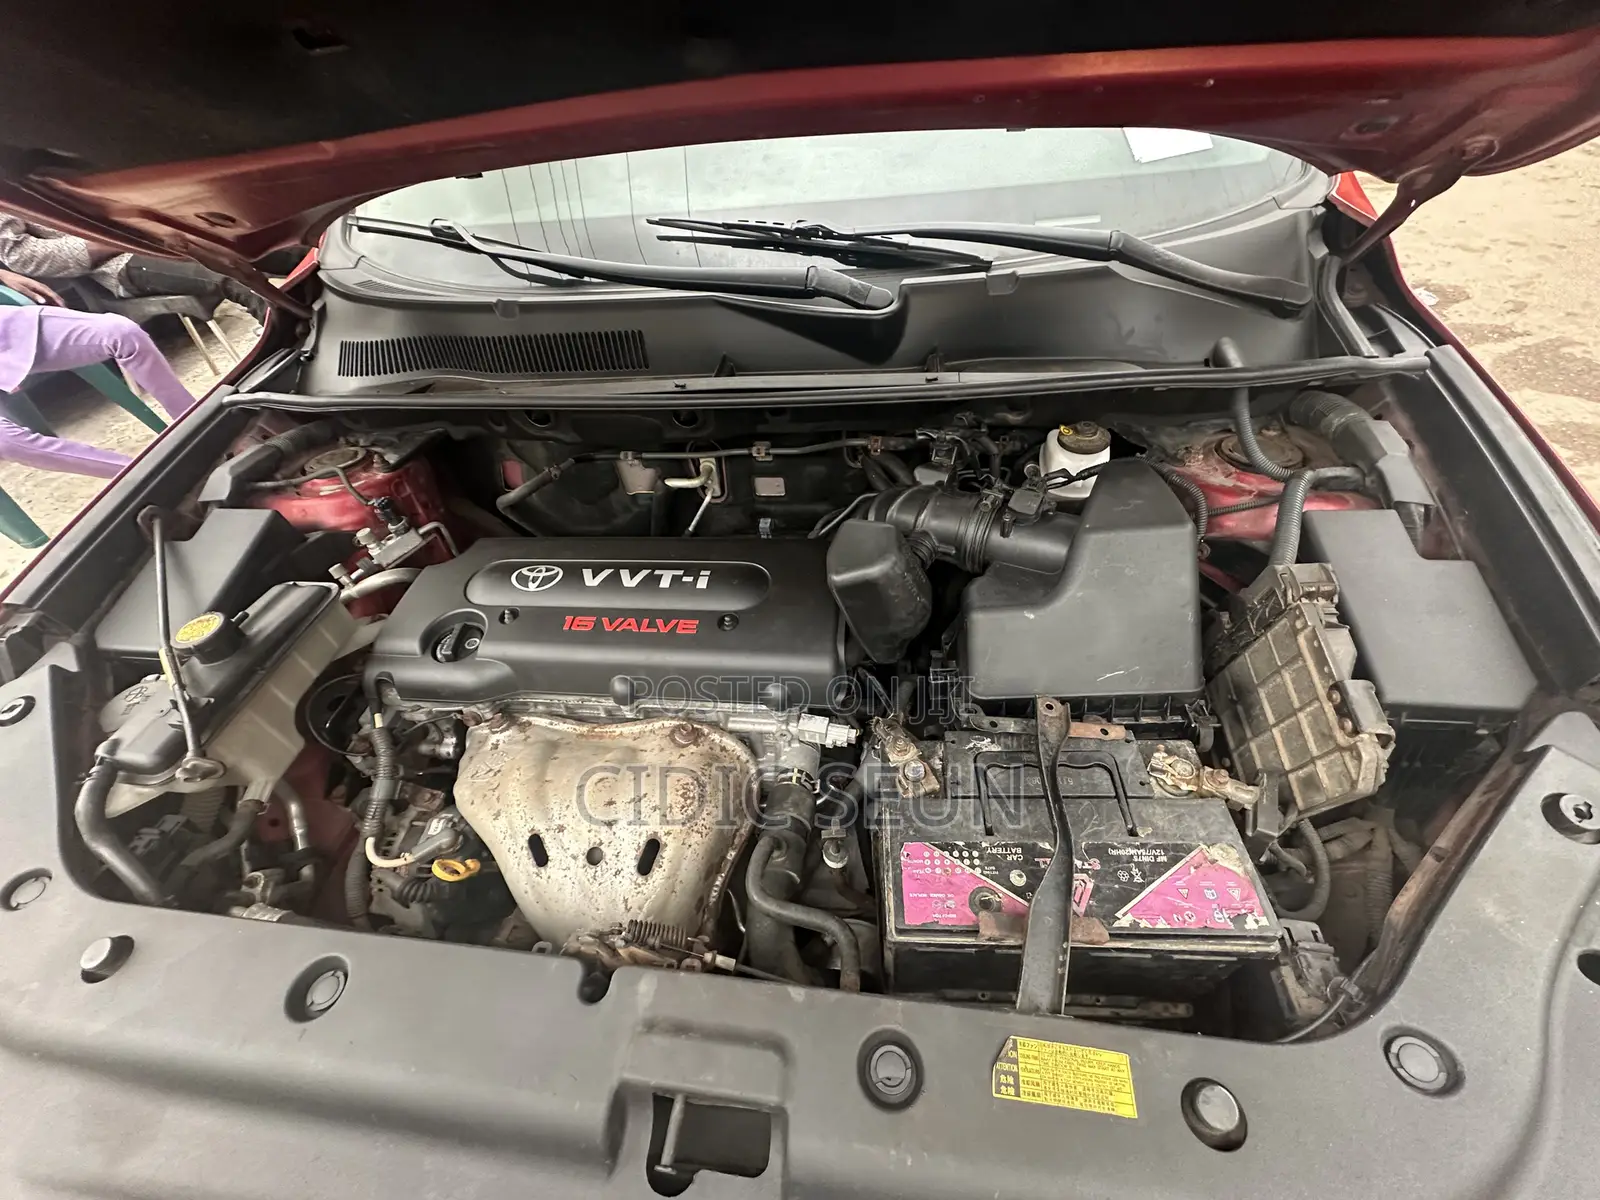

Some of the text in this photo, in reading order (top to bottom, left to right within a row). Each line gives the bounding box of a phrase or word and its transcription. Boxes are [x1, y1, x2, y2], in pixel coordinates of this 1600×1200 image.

[582, 568, 711, 589] VVT-i
[563, 615, 699, 634] 16 VALVE
